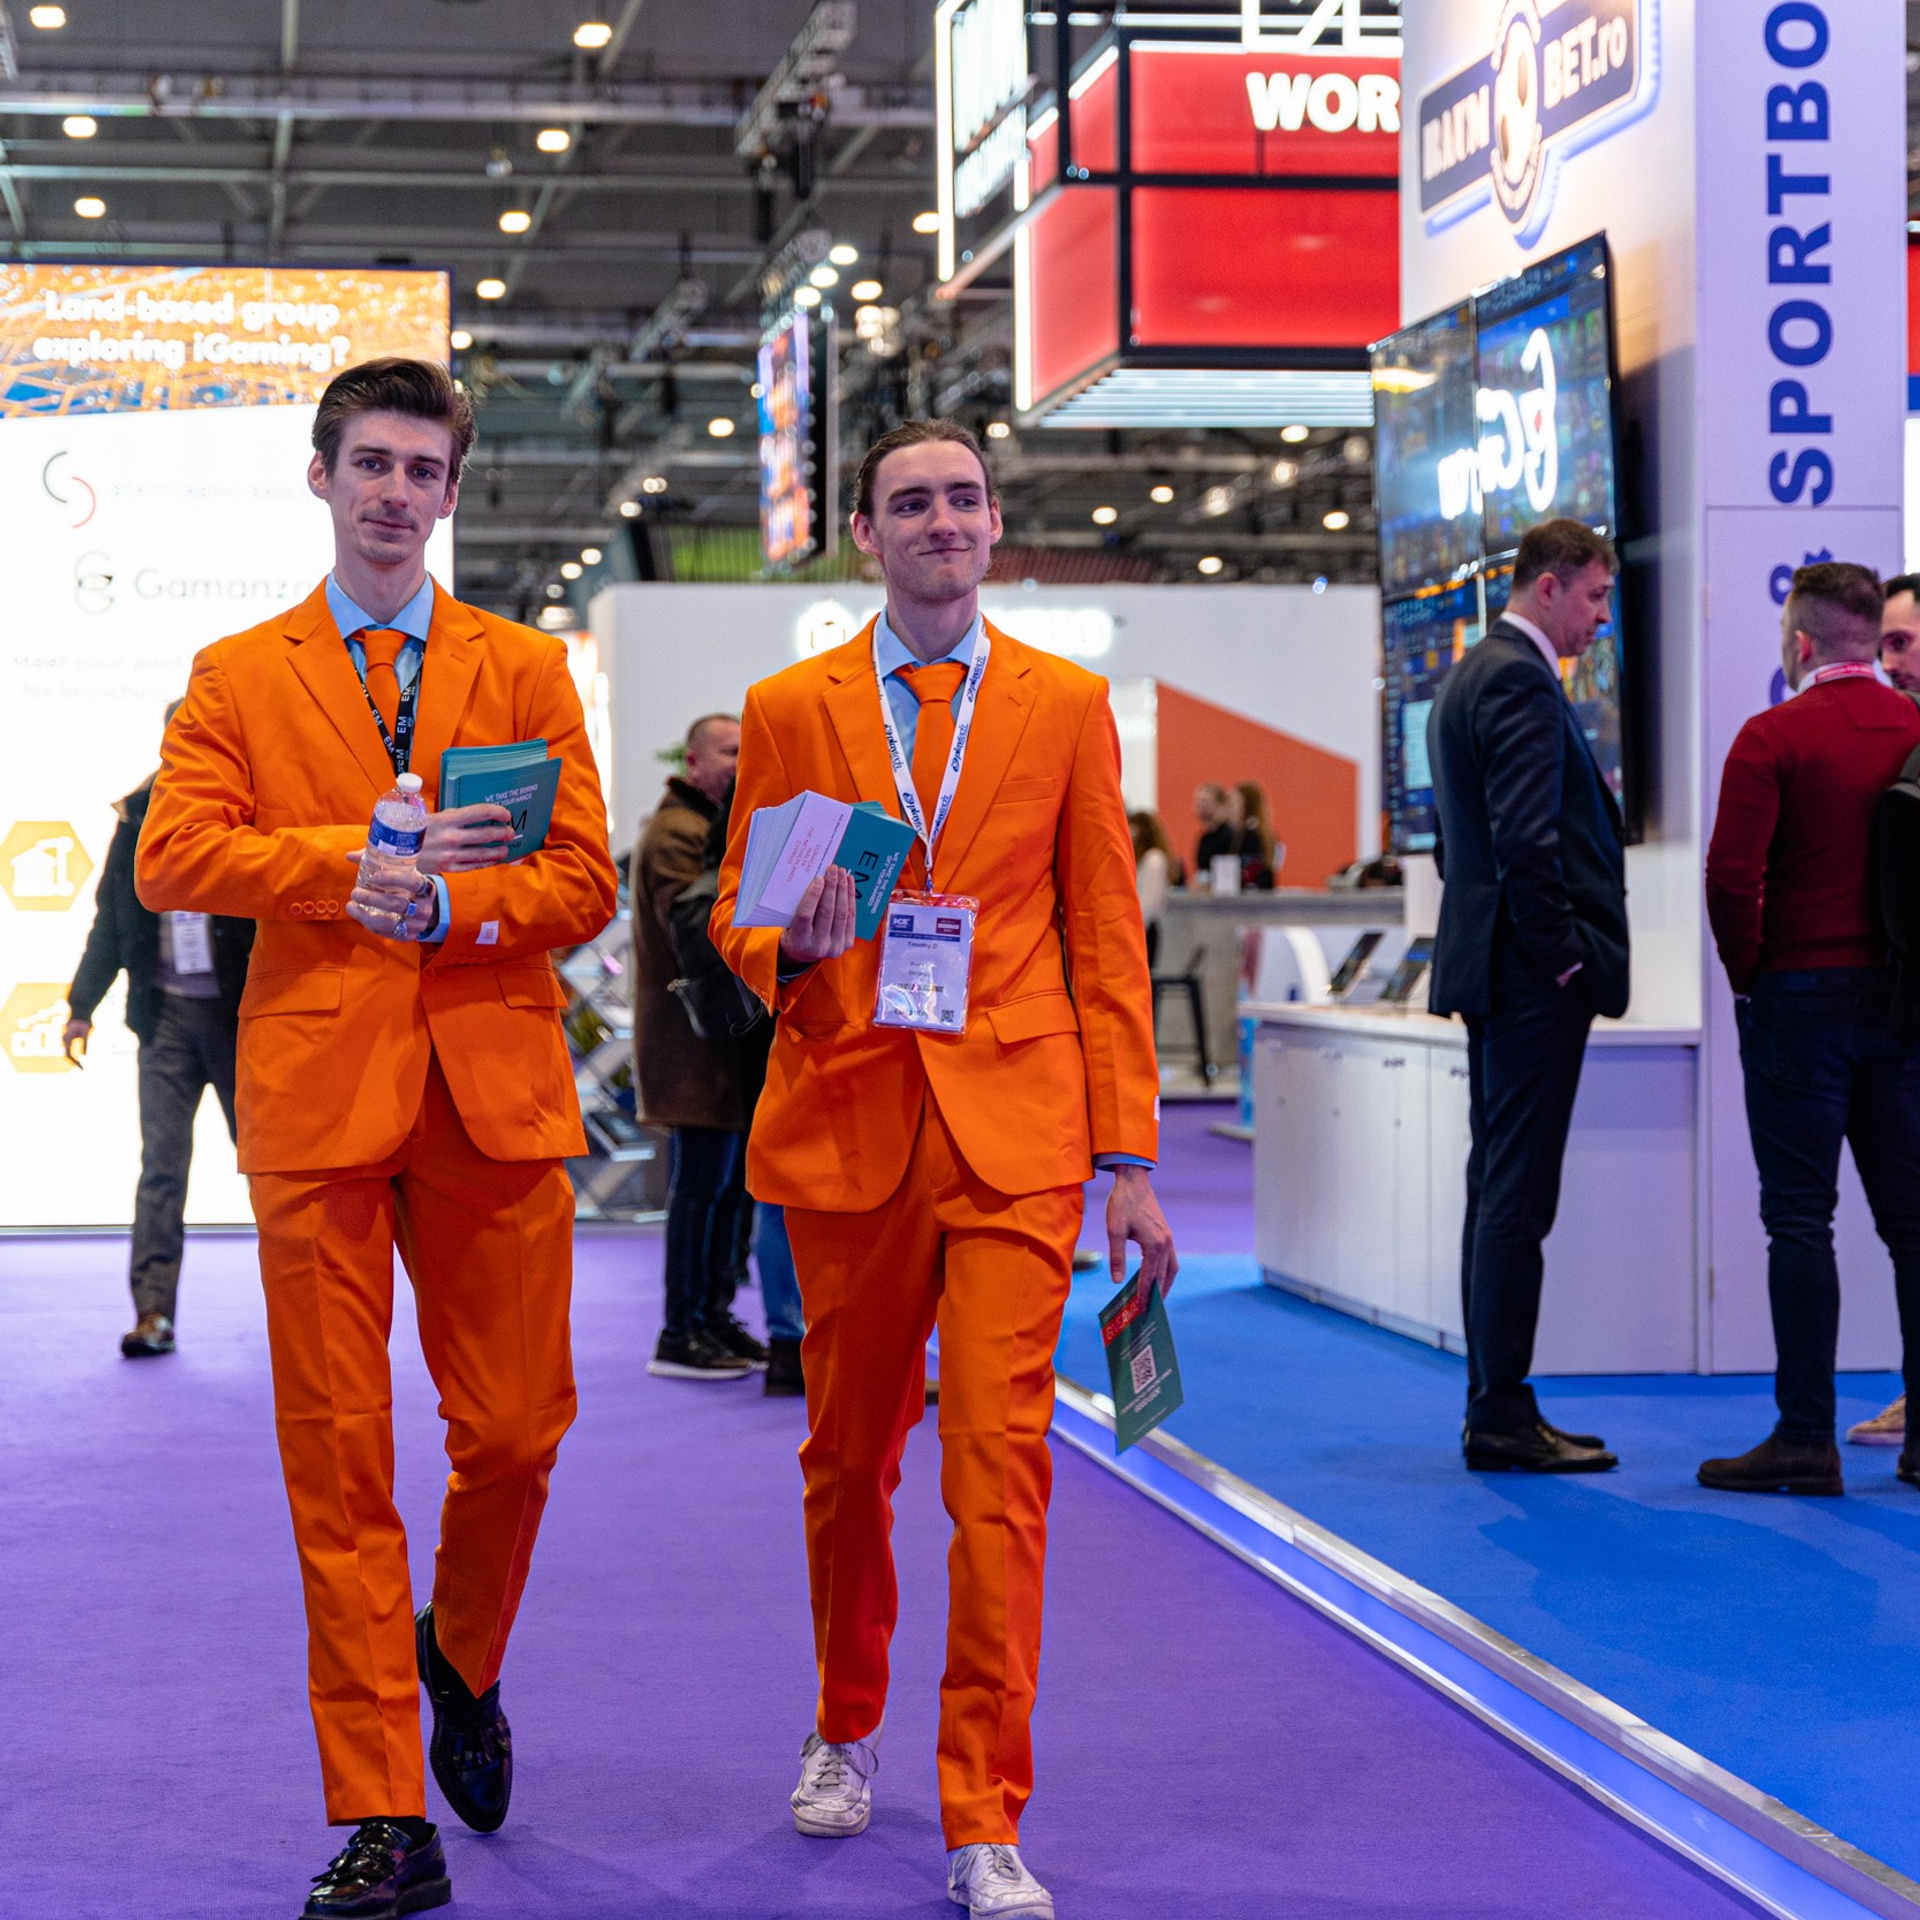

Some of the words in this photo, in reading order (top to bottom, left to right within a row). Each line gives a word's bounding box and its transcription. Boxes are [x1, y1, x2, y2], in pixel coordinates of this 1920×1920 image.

[1245, 72, 1400, 133] WOR
[1765, 1, 1834, 509] SPORTBO
[45, 290, 234, 324] Land-based
[241, 301, 340, 333] group
[33, 329, 186, 370] exploring
[193, 331, 351, 371] iGaming?
[397, 716, 407, 734] EM
